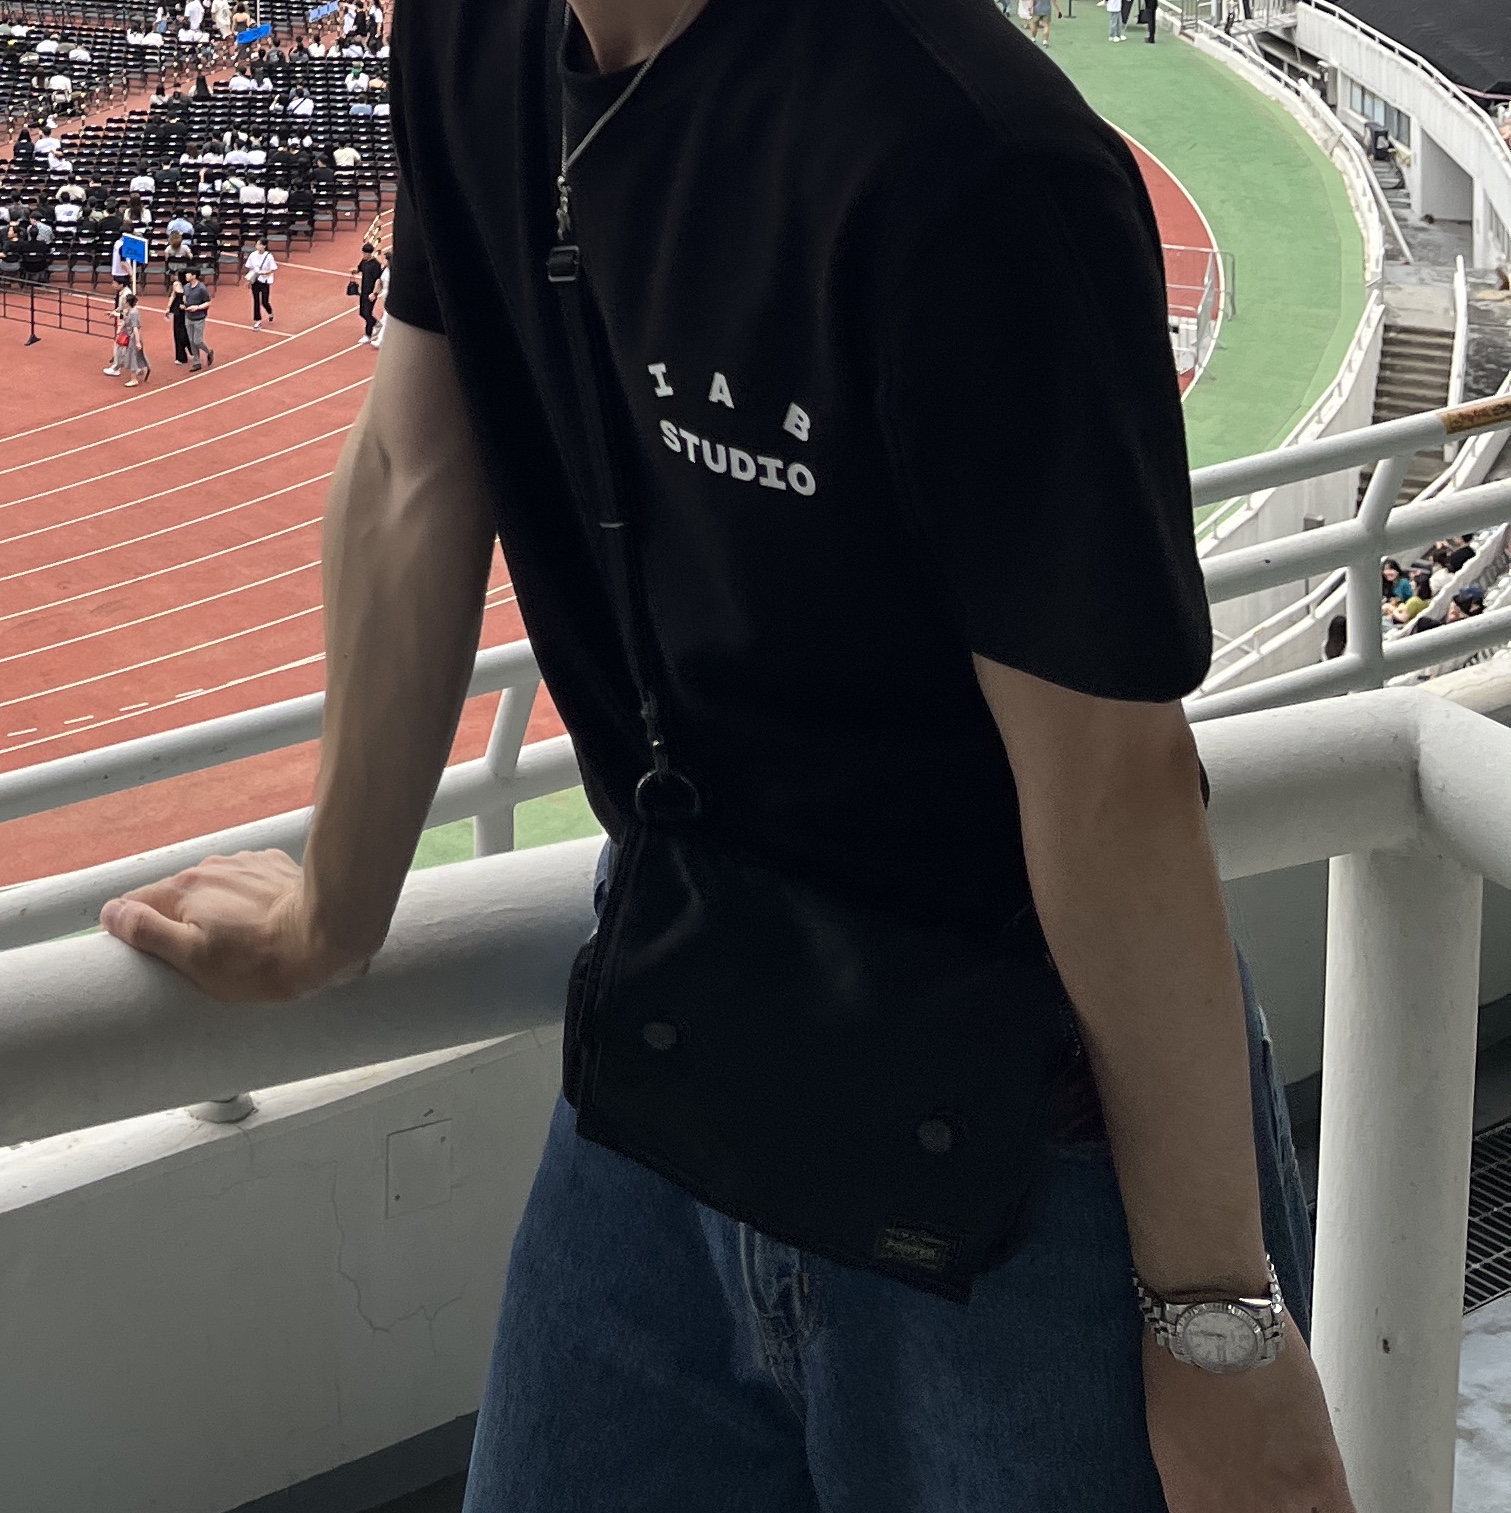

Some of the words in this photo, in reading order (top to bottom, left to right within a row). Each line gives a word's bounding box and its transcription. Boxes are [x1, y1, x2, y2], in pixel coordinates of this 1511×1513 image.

[647, 362, 674, 398] I
[708, 371, 735, 409] A
[782, 401, 812, 442] B
[659, 419, 817, 497] STUDIO
